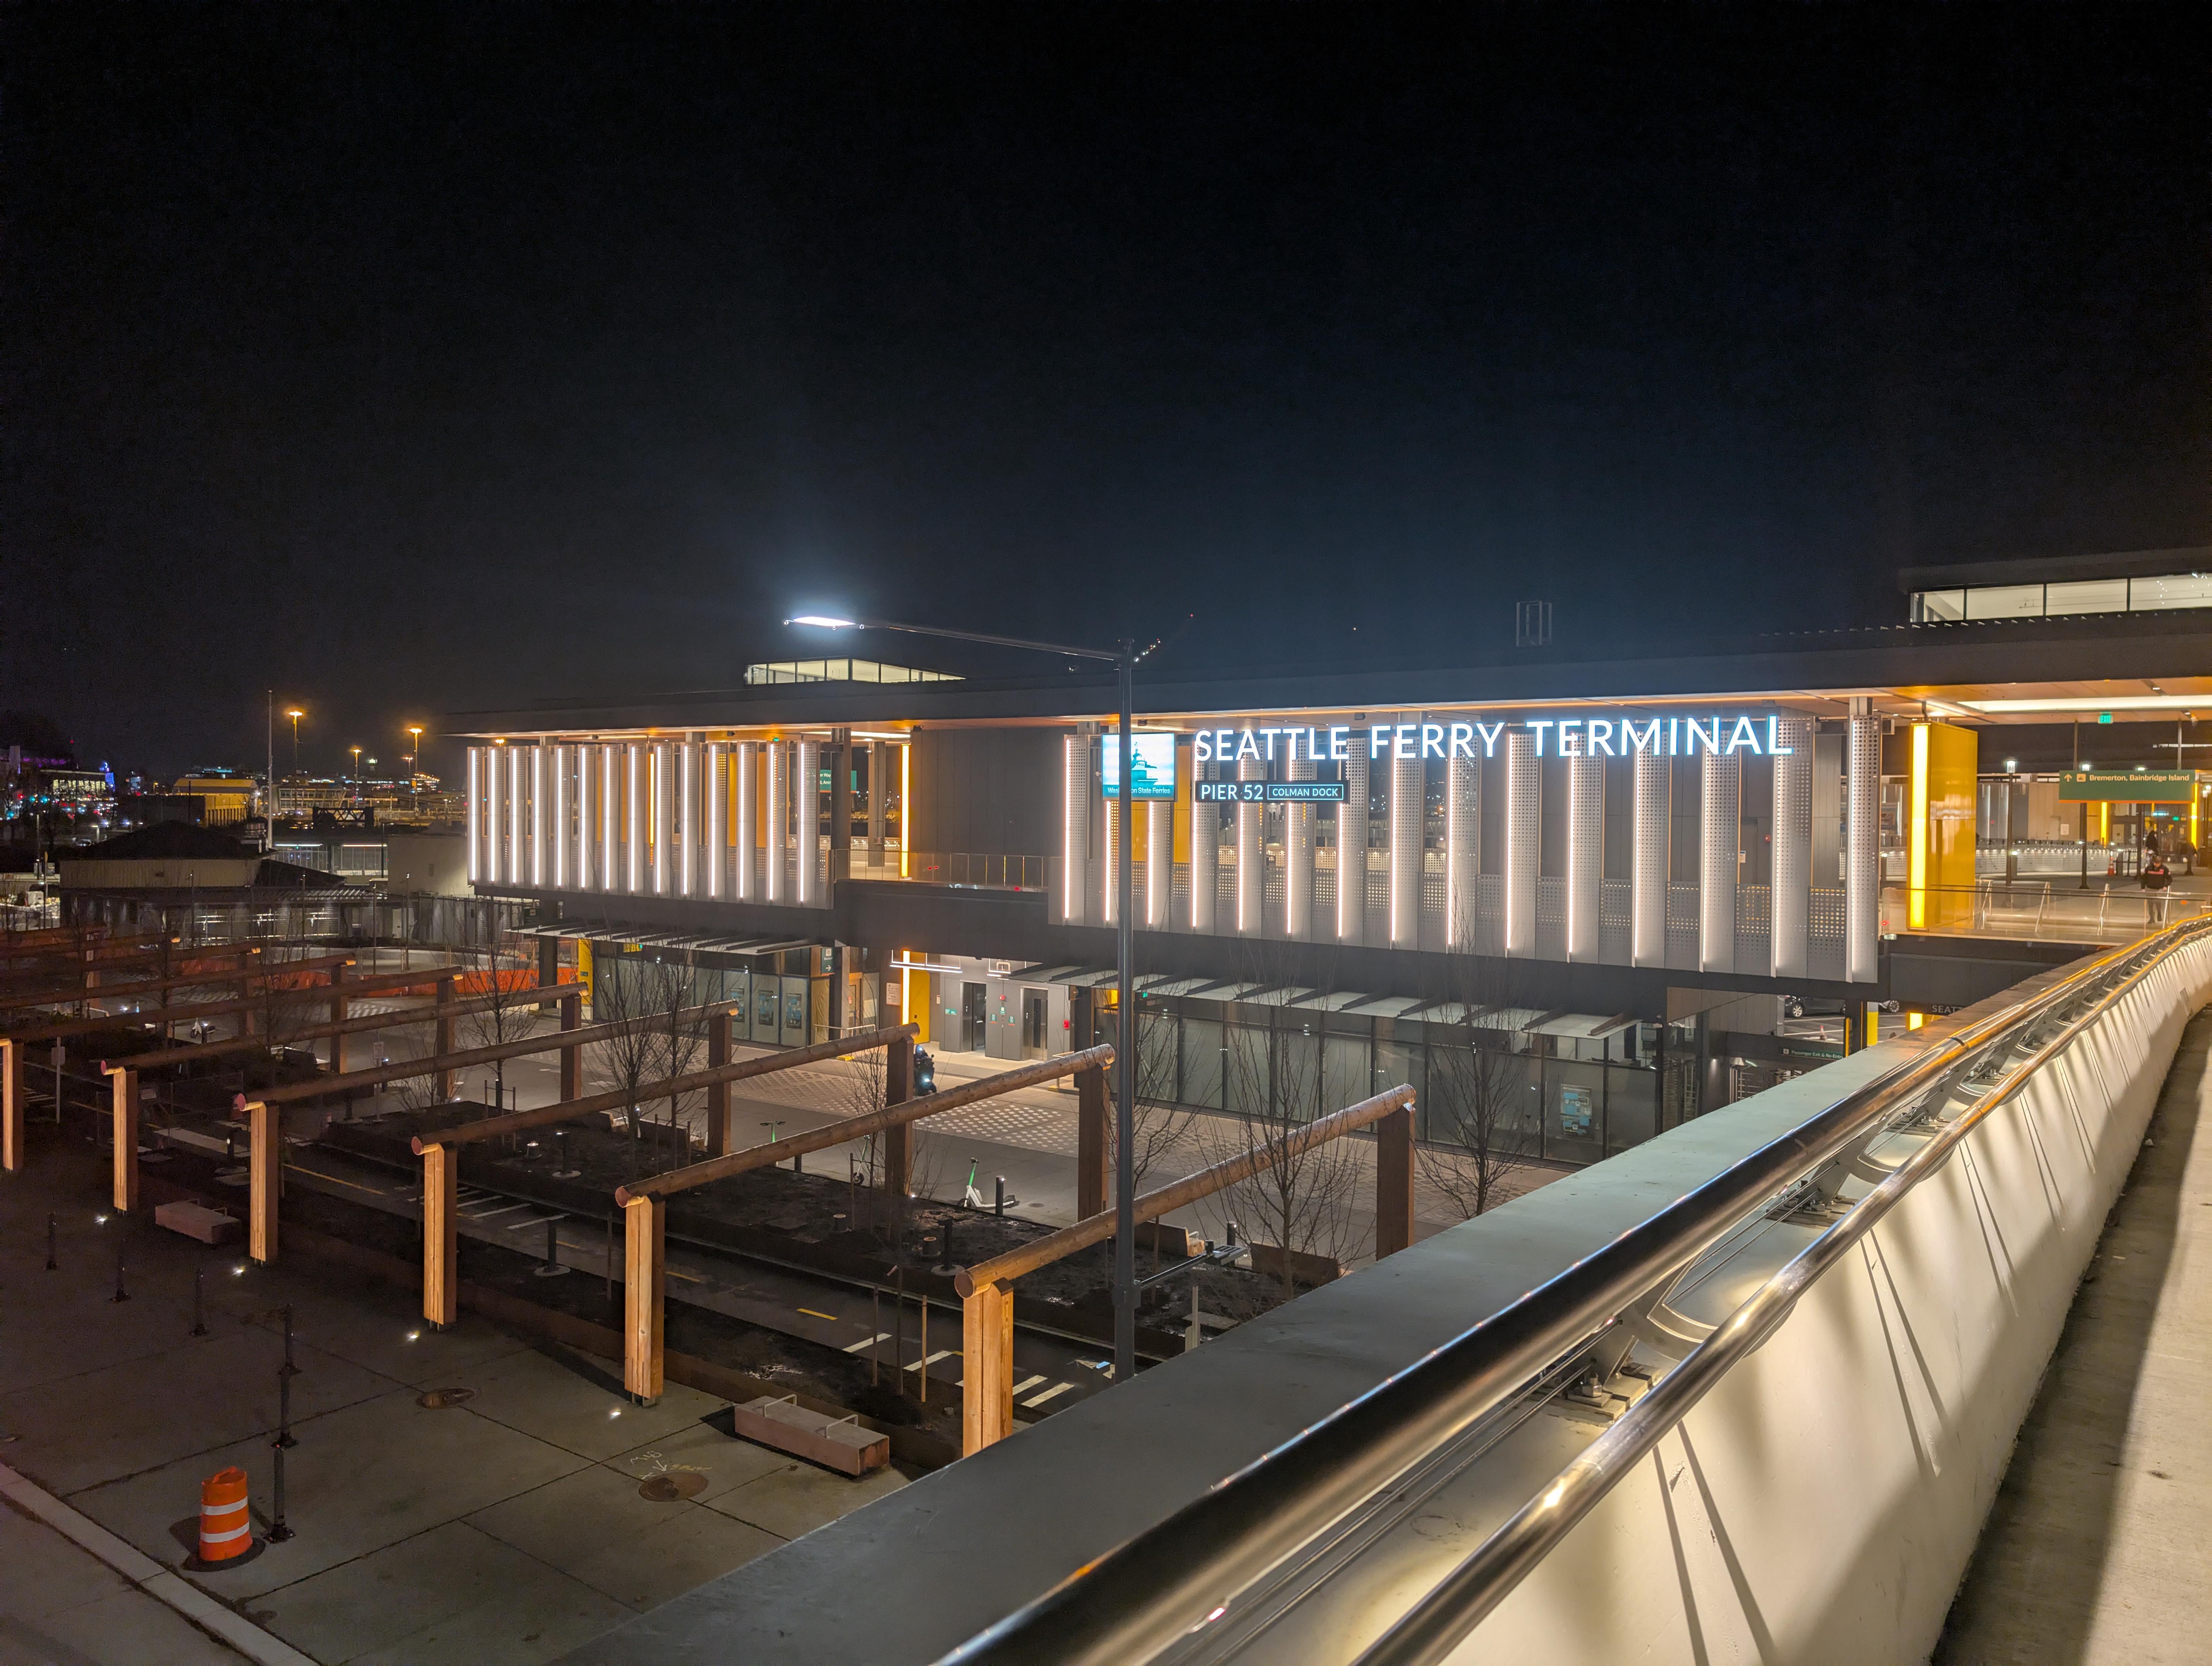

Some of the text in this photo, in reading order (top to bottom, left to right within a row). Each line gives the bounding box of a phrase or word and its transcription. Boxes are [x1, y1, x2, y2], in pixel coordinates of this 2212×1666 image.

[1195, 716, 1793, 761] SEATTLE FERRY TERMINAL
[1201, 784, 1263, 800] PIER 52
[1272, 788, 1338, 796] COLMAN DOCK
